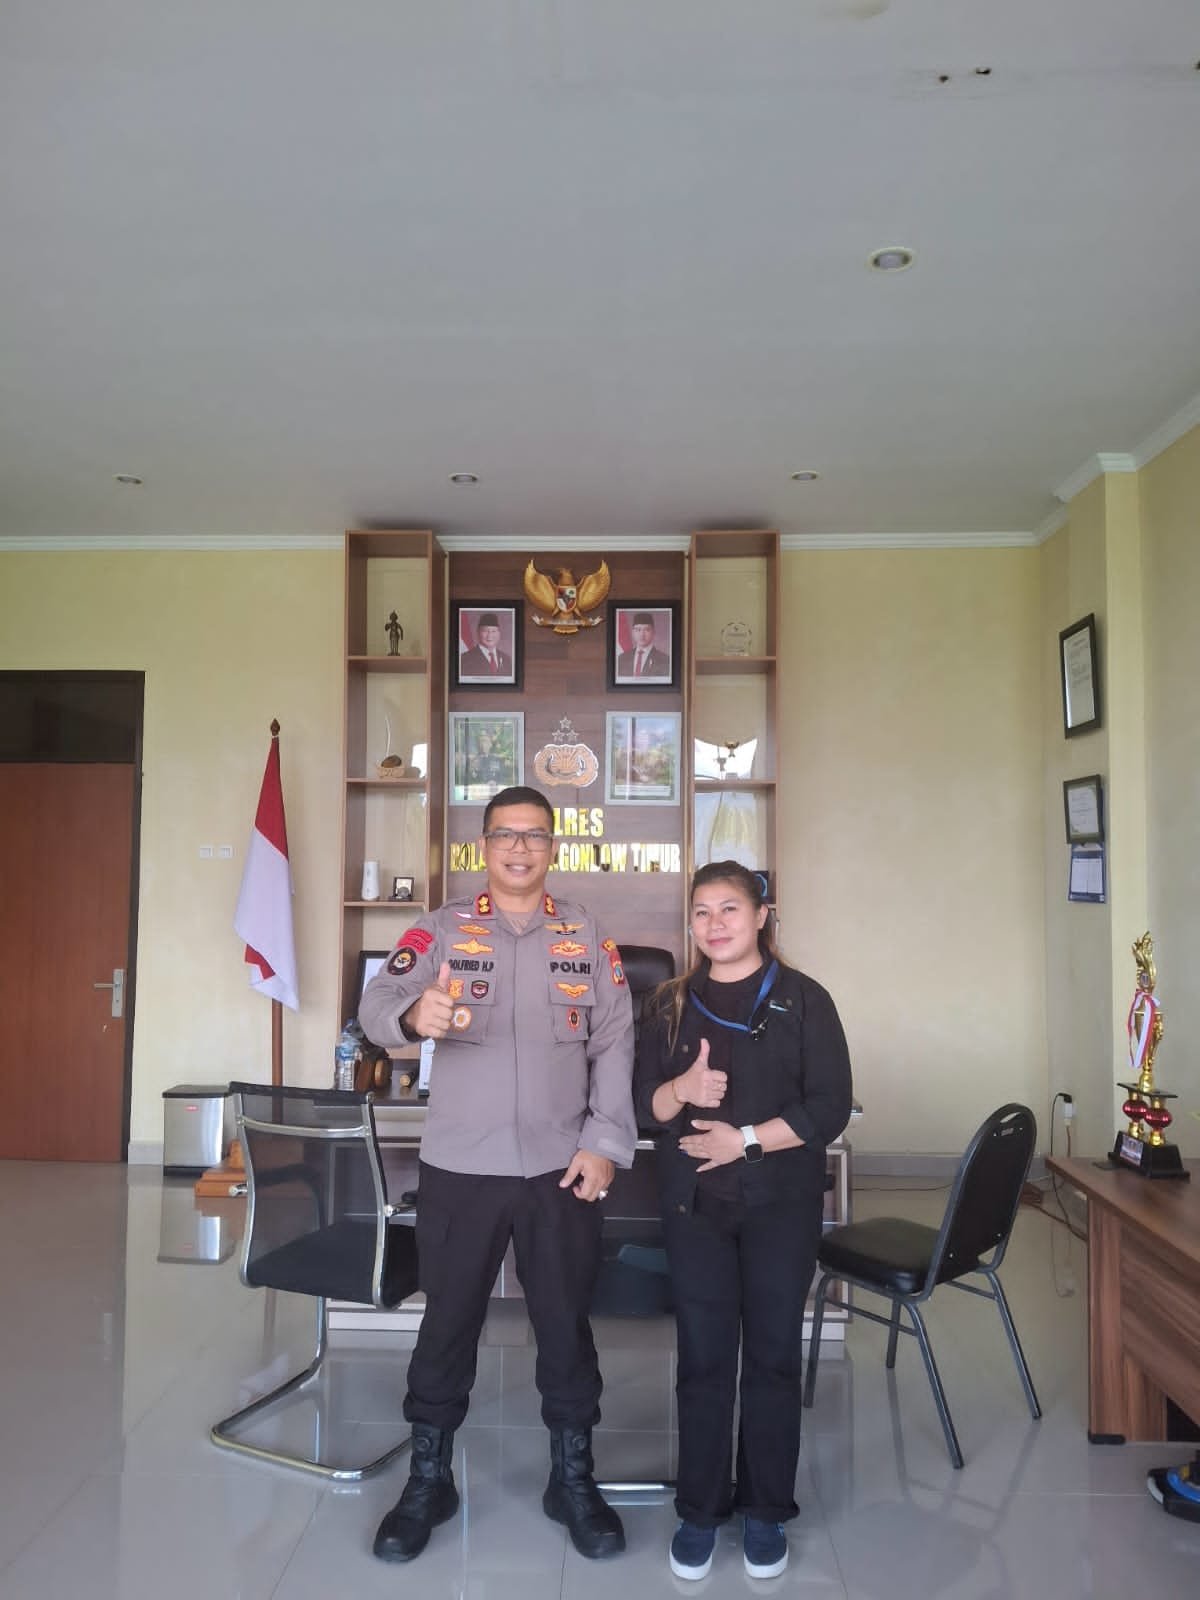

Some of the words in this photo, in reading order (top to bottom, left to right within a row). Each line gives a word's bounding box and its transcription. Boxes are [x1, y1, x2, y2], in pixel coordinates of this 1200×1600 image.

[552, 807, 604, 837] LRES
[548, 843, 627, 872] GONDOW
[550, 961, 591, 974] POLRI
